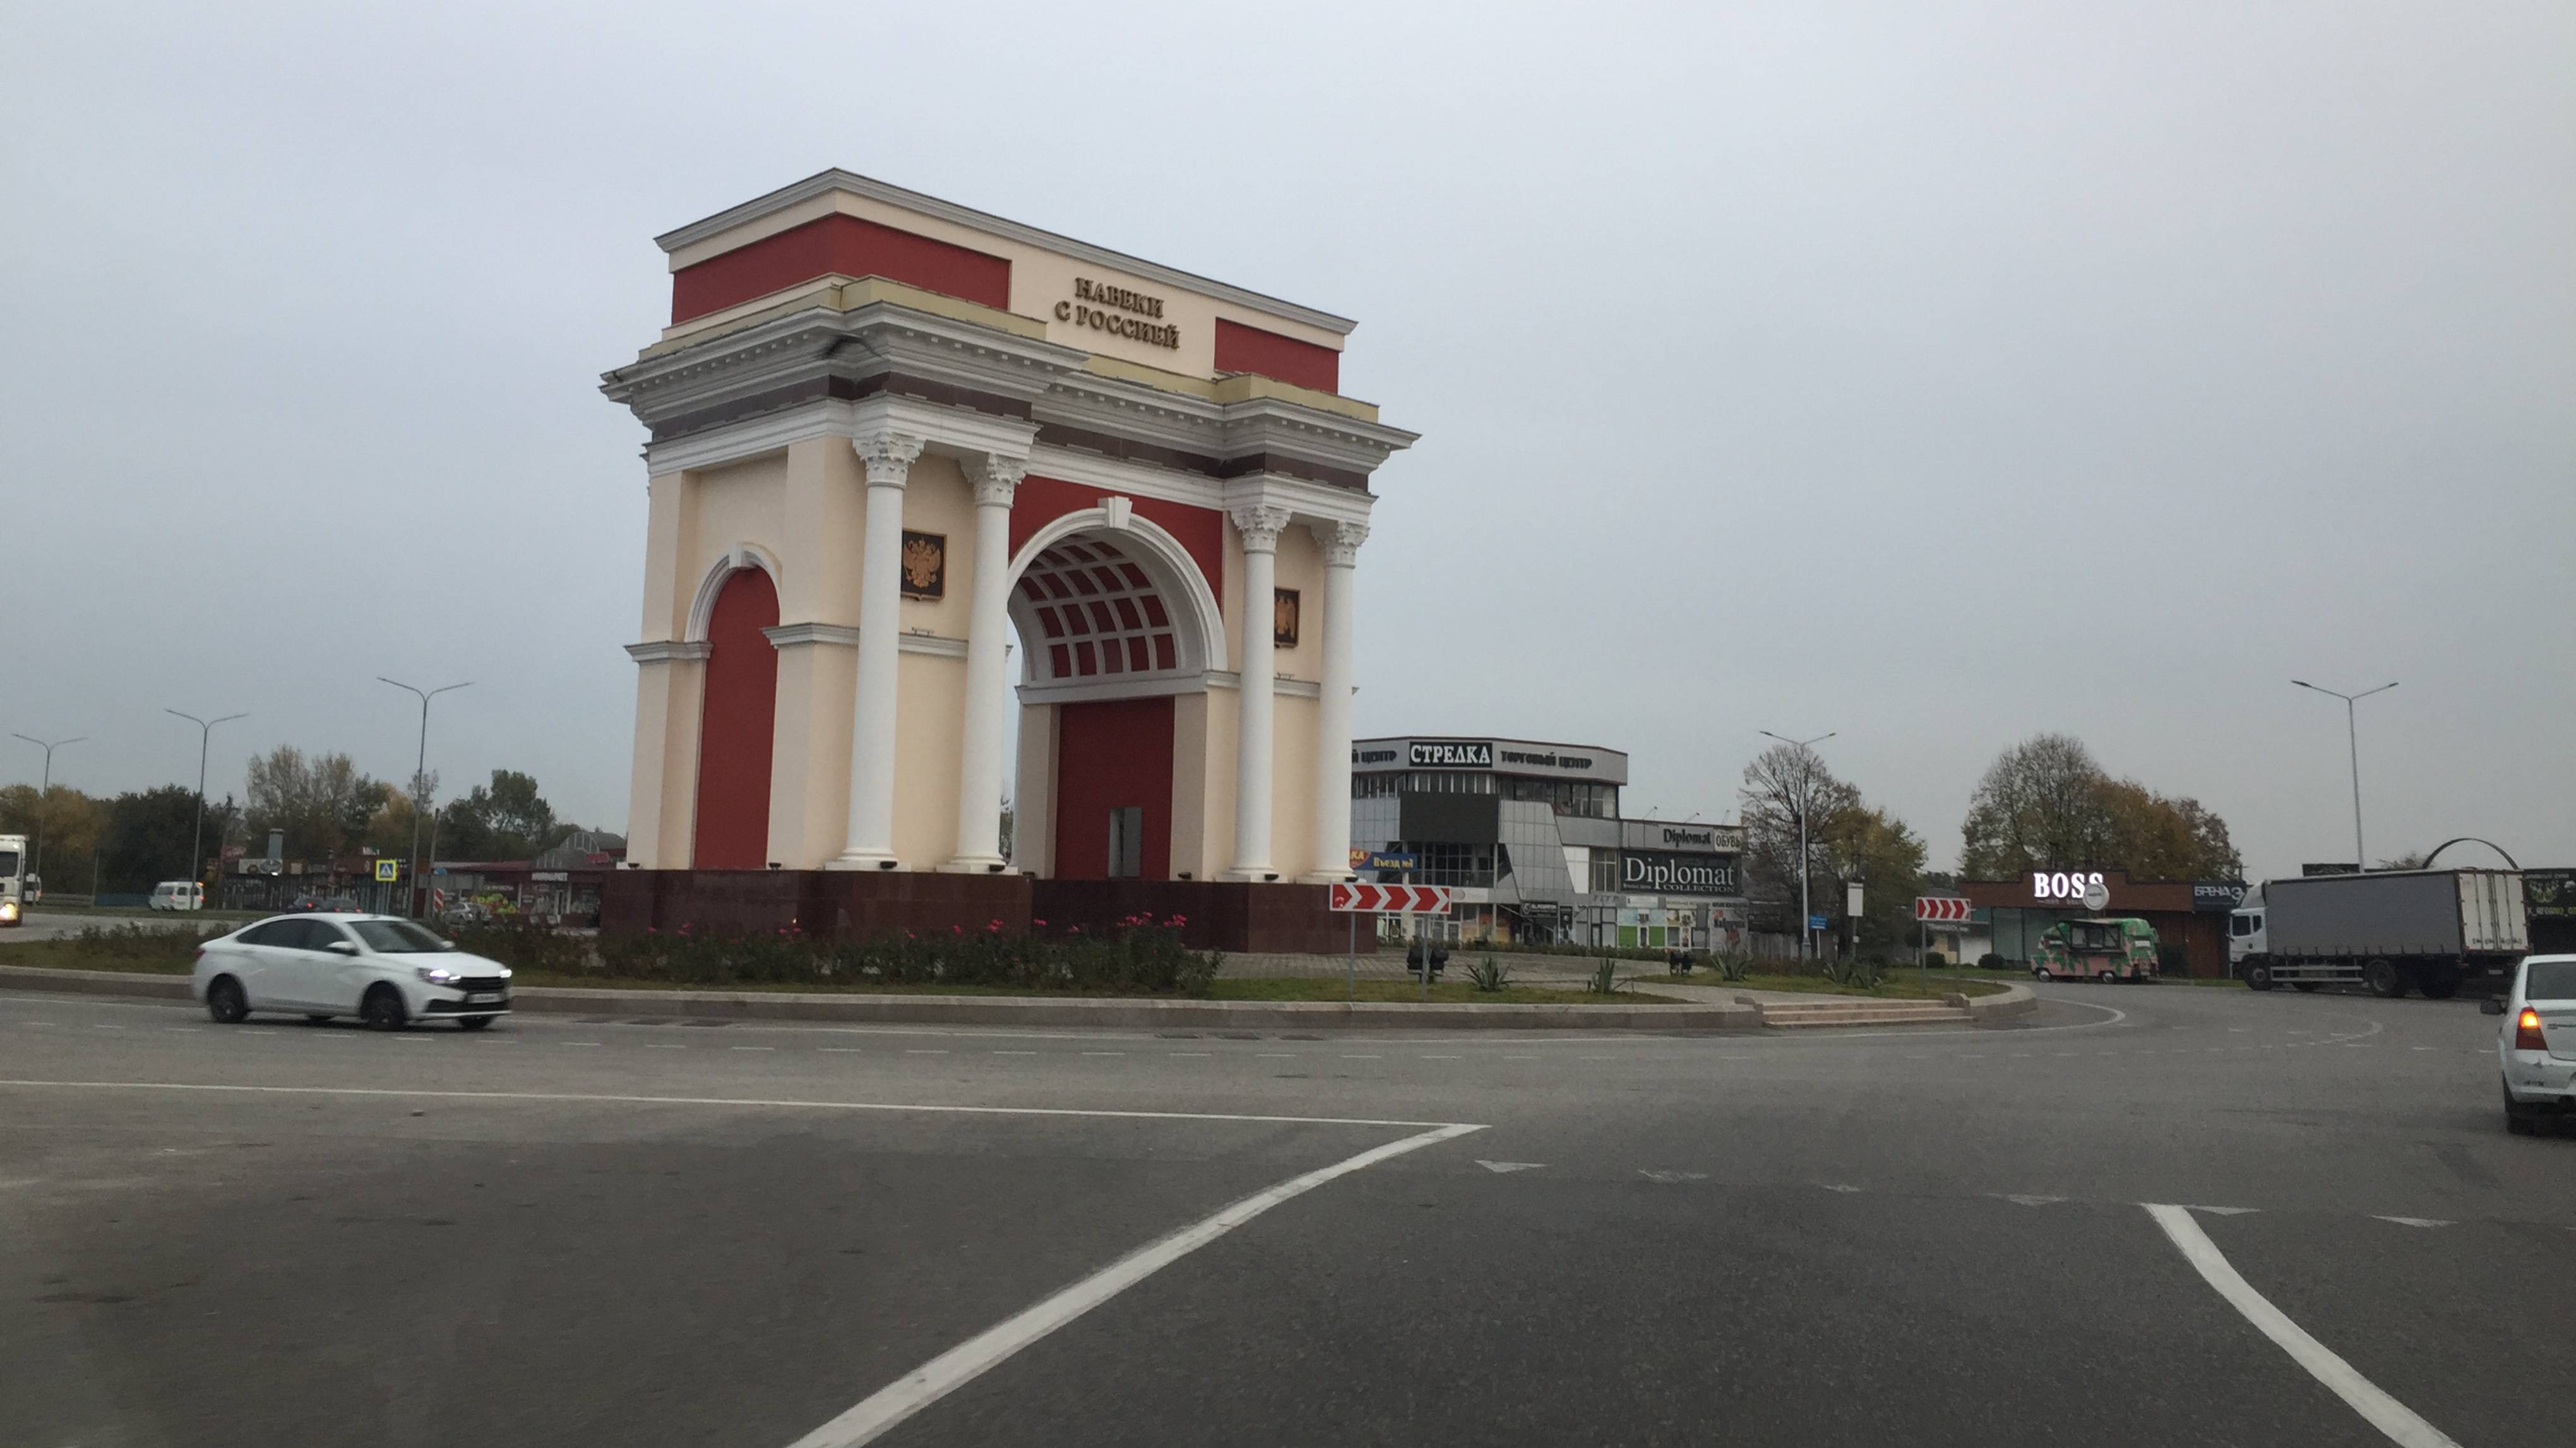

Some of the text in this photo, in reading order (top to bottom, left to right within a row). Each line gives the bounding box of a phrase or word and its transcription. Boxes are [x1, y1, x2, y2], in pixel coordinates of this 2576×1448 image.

[1075, 277, 1164, 318] НАВЕКИ
[1055, 300, 1180, 349] С РОССИЕЙ
[1410, 745, 1491, 764] СТРЕЛКА
[1663, 828, 1712, 848] Diplomat
[1625, 857, 1734, 890] Diplomat
[1662, 884, 1734, 893] COLLECTION
